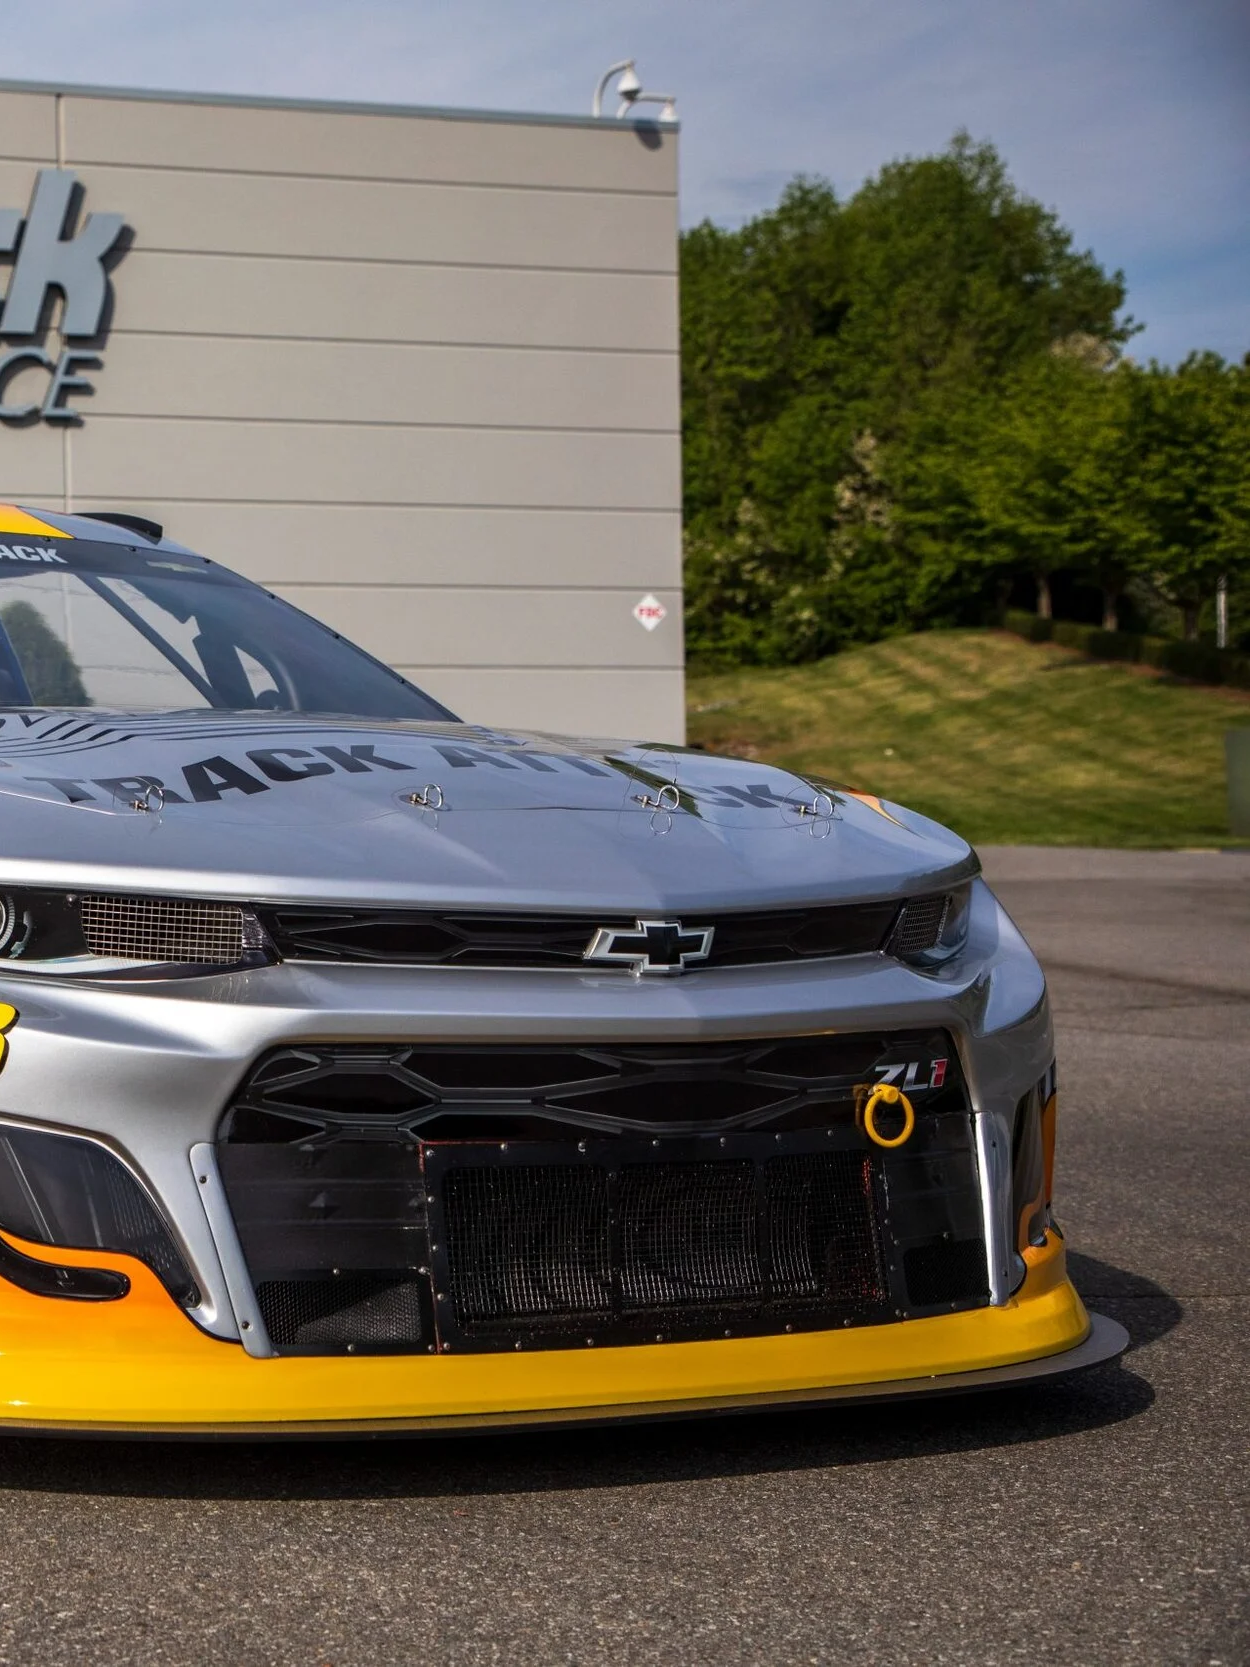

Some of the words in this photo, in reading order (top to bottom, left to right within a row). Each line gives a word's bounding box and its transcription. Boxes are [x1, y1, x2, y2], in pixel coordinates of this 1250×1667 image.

[23, 744, 418, 804] TRACK
[431, 744, 813, 808] ATTCK
[867, 1058, 948, 1095] ZL1
